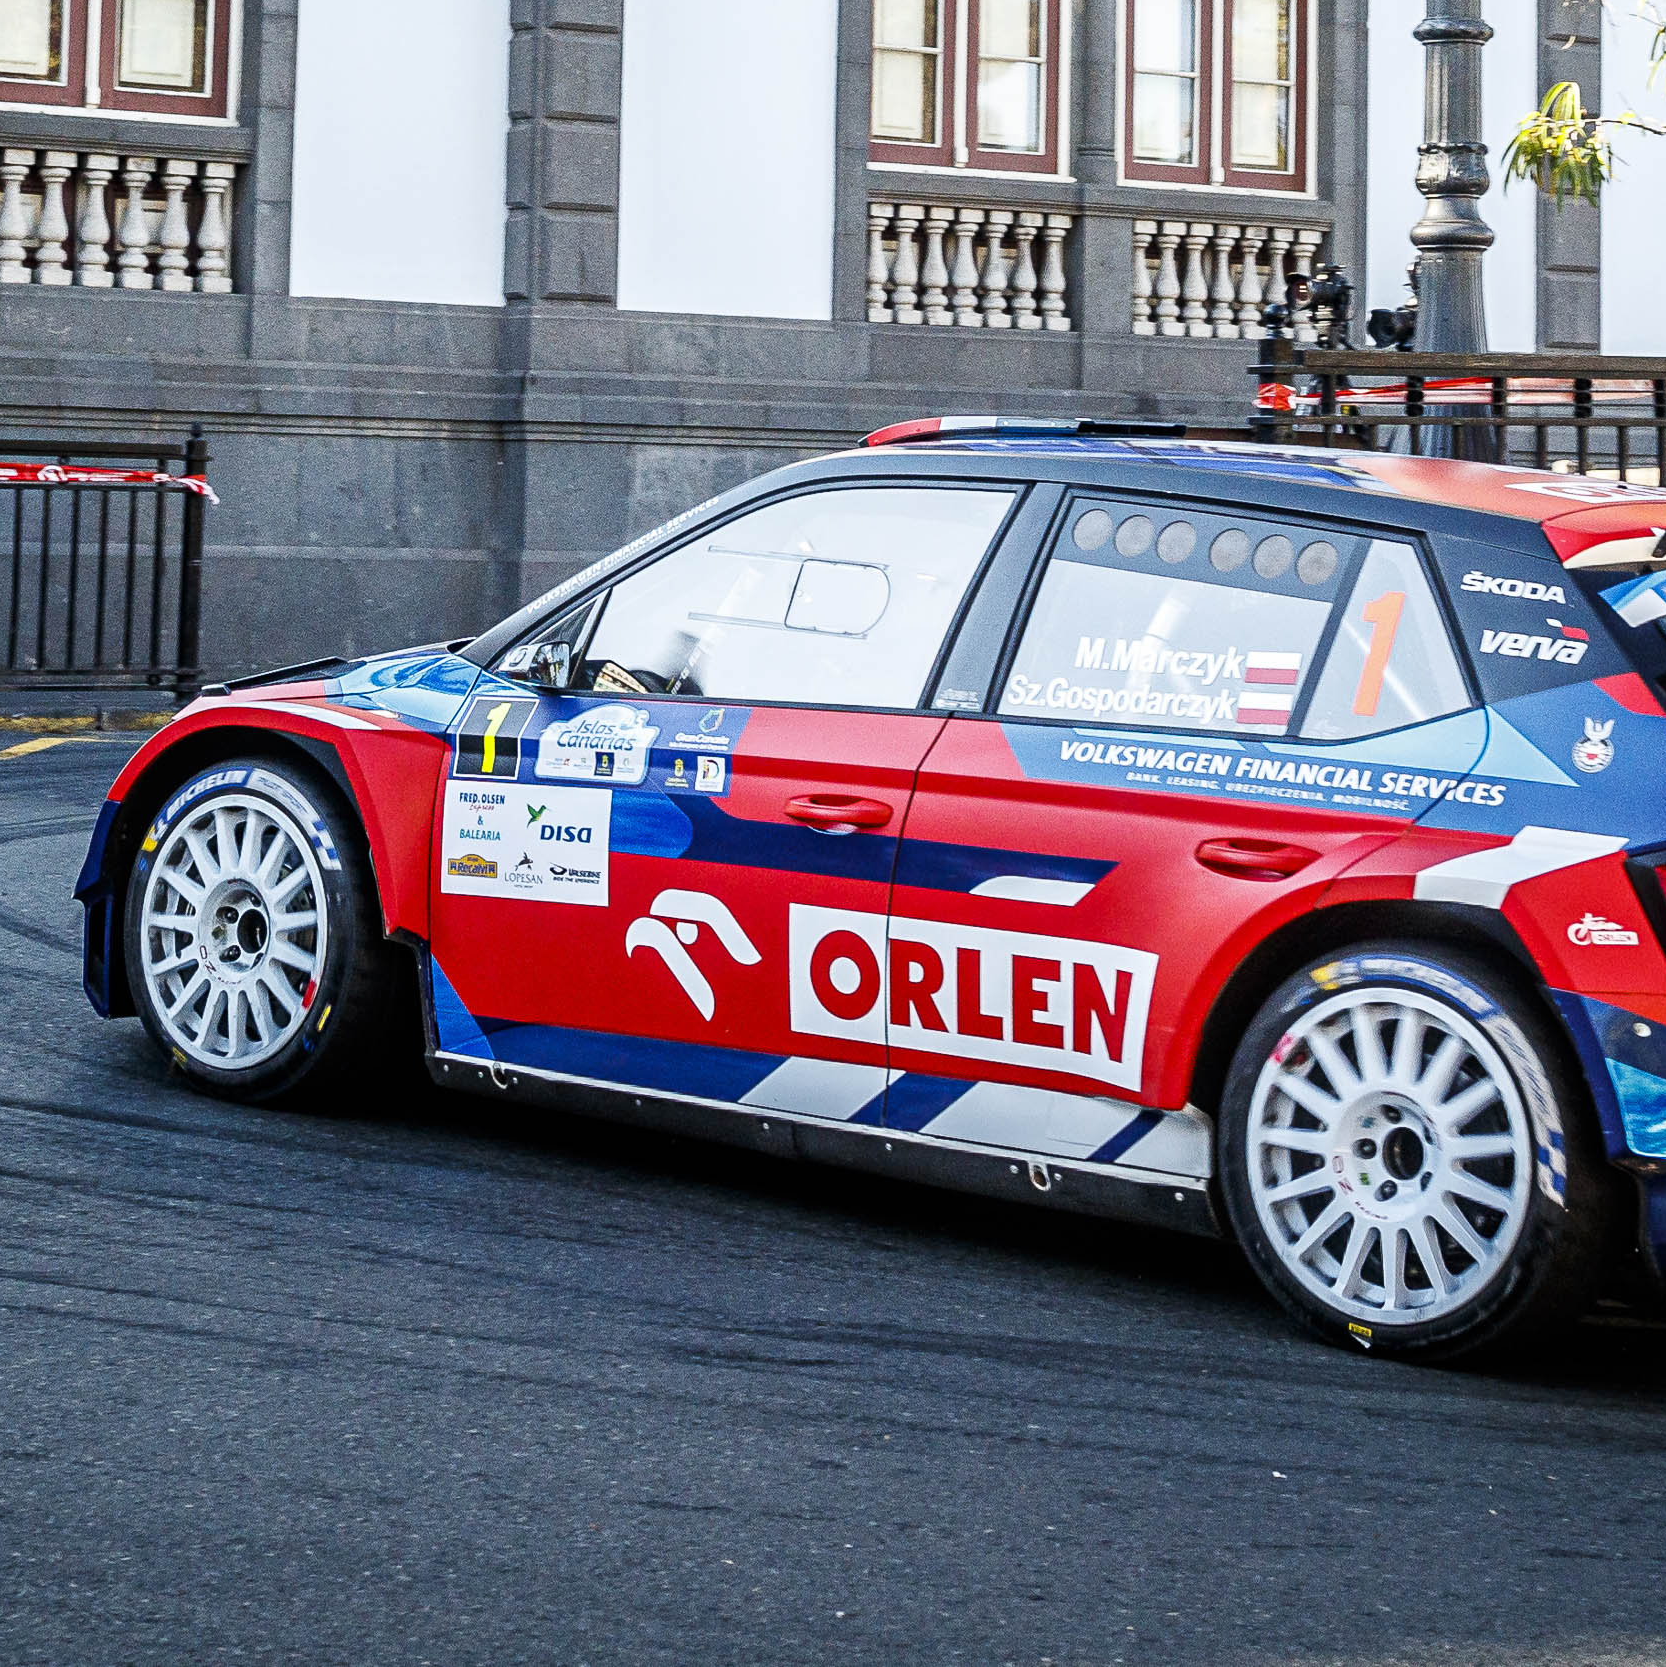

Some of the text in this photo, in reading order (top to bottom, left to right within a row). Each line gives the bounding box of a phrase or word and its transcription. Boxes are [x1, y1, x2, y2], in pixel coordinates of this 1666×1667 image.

[526, 561, 602, 615] VOLKSWAGEN
[604, 527, 664, 567] FINANCIAL
[666, 496, 720, 530] SERVICES
[1460, 570, 1567, 605] ŠKODA
[1352, 590, 1407, 716] 1
[1479, 629, 1589, 665] verva
[1007, 674, 1237, 725] Sz.Gospodarczyk
[481, 702, 513, 774] 1
[557, 730, 634, 752] Canarias
[577, 719, 617, 735] Islas
[1059, 739, 1507, 807] VOLKSWAGEN FINANCIAL SERVICES
[459, 828, 501, 841] BALEARIA
[477, 815, 484, 826] &
[504, 872, 544, 885] LOPESAN
[809, 929, 1133, 1064] ORLEN
